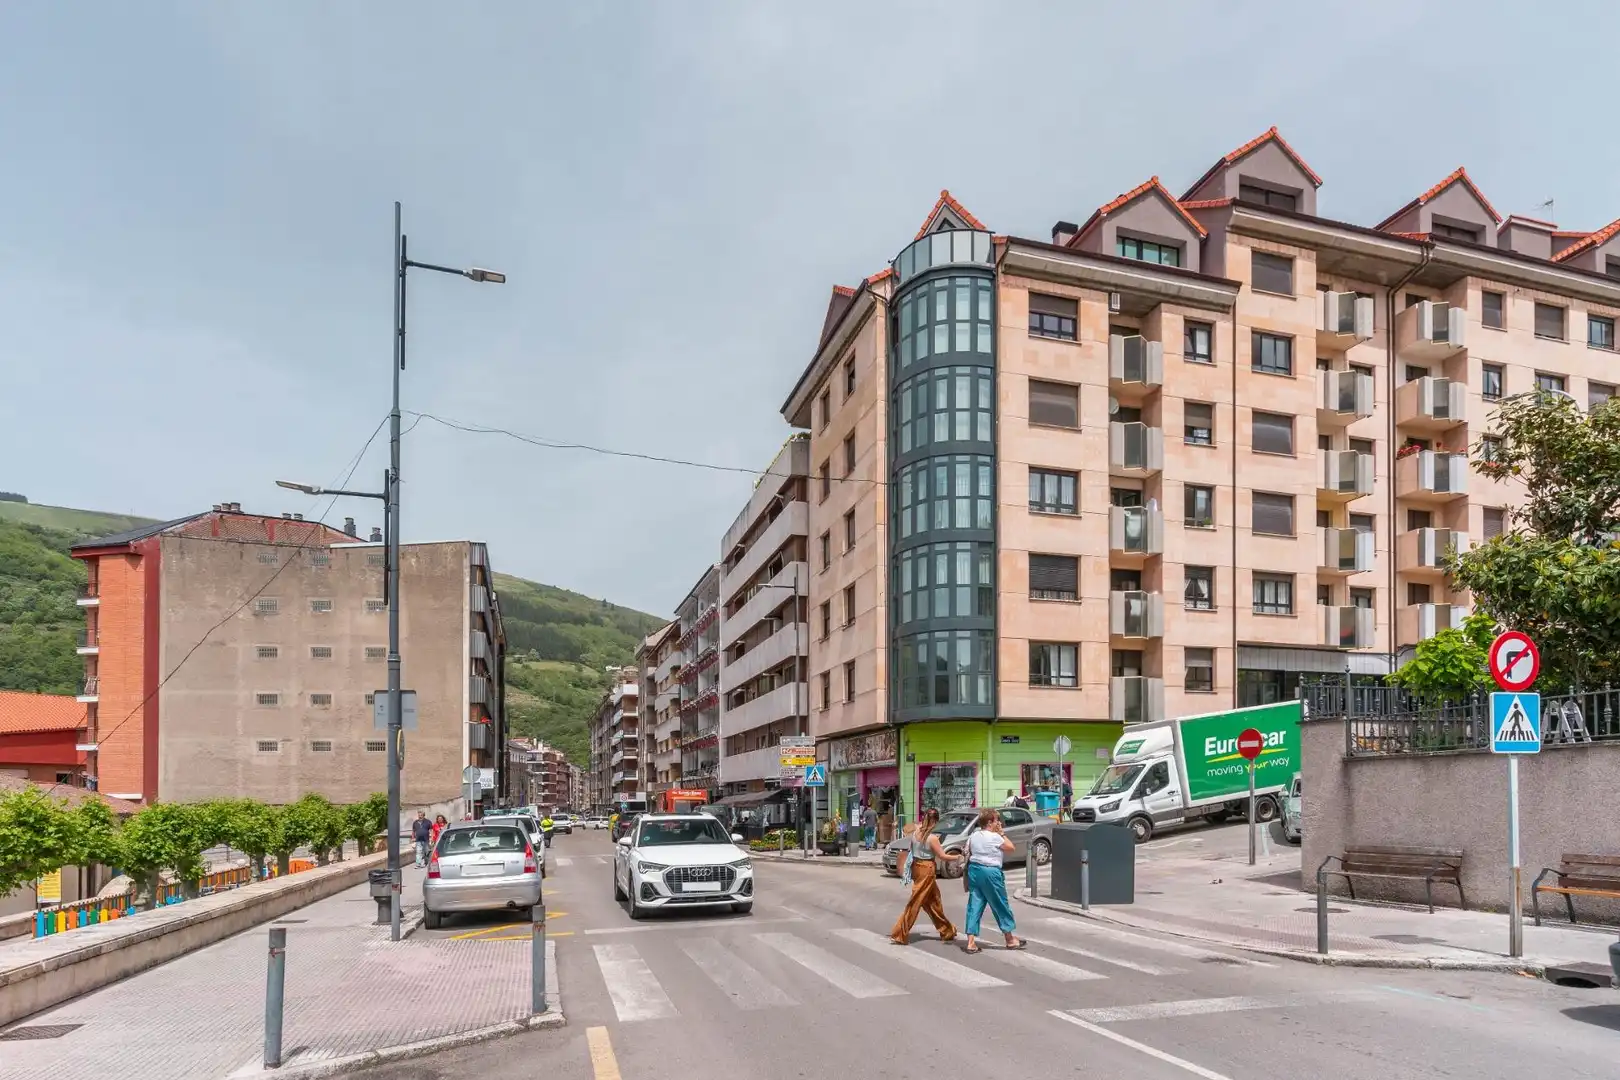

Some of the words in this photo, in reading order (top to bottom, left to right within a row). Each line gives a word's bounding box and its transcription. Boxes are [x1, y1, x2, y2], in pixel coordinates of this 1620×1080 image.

[1205, 731, 1286, 756] Eurcar
[1207, 765, 1243, 776] moving
[1269, 757, 1289, 766] way
